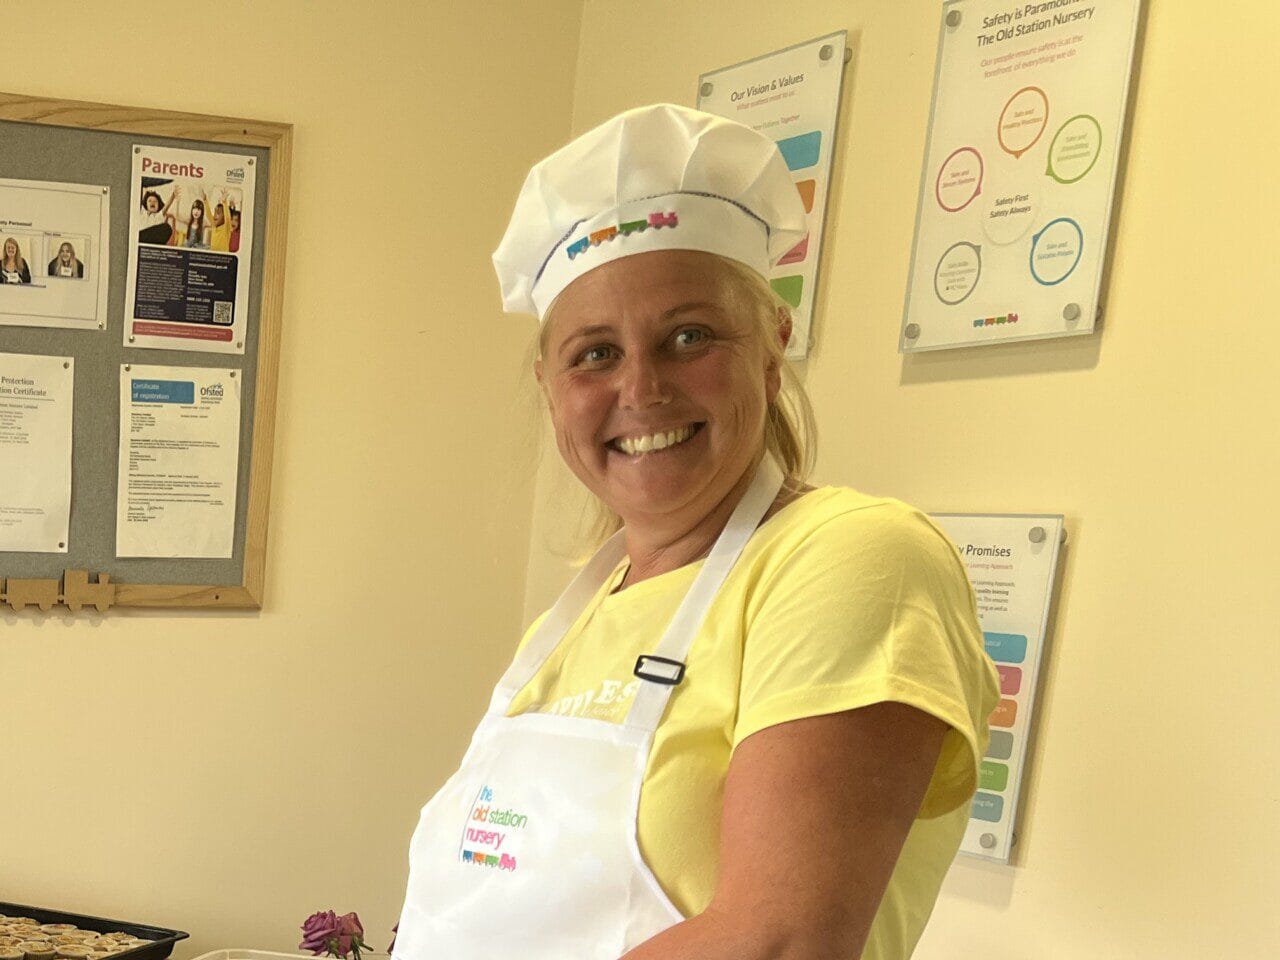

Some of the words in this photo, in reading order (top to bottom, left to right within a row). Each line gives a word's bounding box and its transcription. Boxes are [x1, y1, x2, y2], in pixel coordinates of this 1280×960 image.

[982, 12, 1013, 29] Safety
[1014, 8, 1023, 20] is
[977, 35, 994, 47] The
[996, 25, 1014, 42] Old
[1015, 19, 1051, 37] Station
[1053, 7, 1095, 27] Nursery
[730, 91, 746, 102] Our
[747, 84, 770, 97] Vision
[770, 80, 776, 91] &
[778, 73, 805, 88] Values
[142, 157, 204, 179] Parents
[995, 197, 1014, 206] Safety
[1015, 194, 1029, 203] First
[989, 209, 1009, 218] Safety
[1010, 205, 1032, 216] Always
[1, 376, 35, 386] Protection
[132, 382, 160, 390] Certificate
[13, 388, 47, 397] Certificate
[200, 387, 224, 397] Ofsted
[966, 544, 1012, 557] Promises
[472, 804, 491, 823] old
[489, 808, 528, 829] station
[466, 827, 506, 850] nursery
